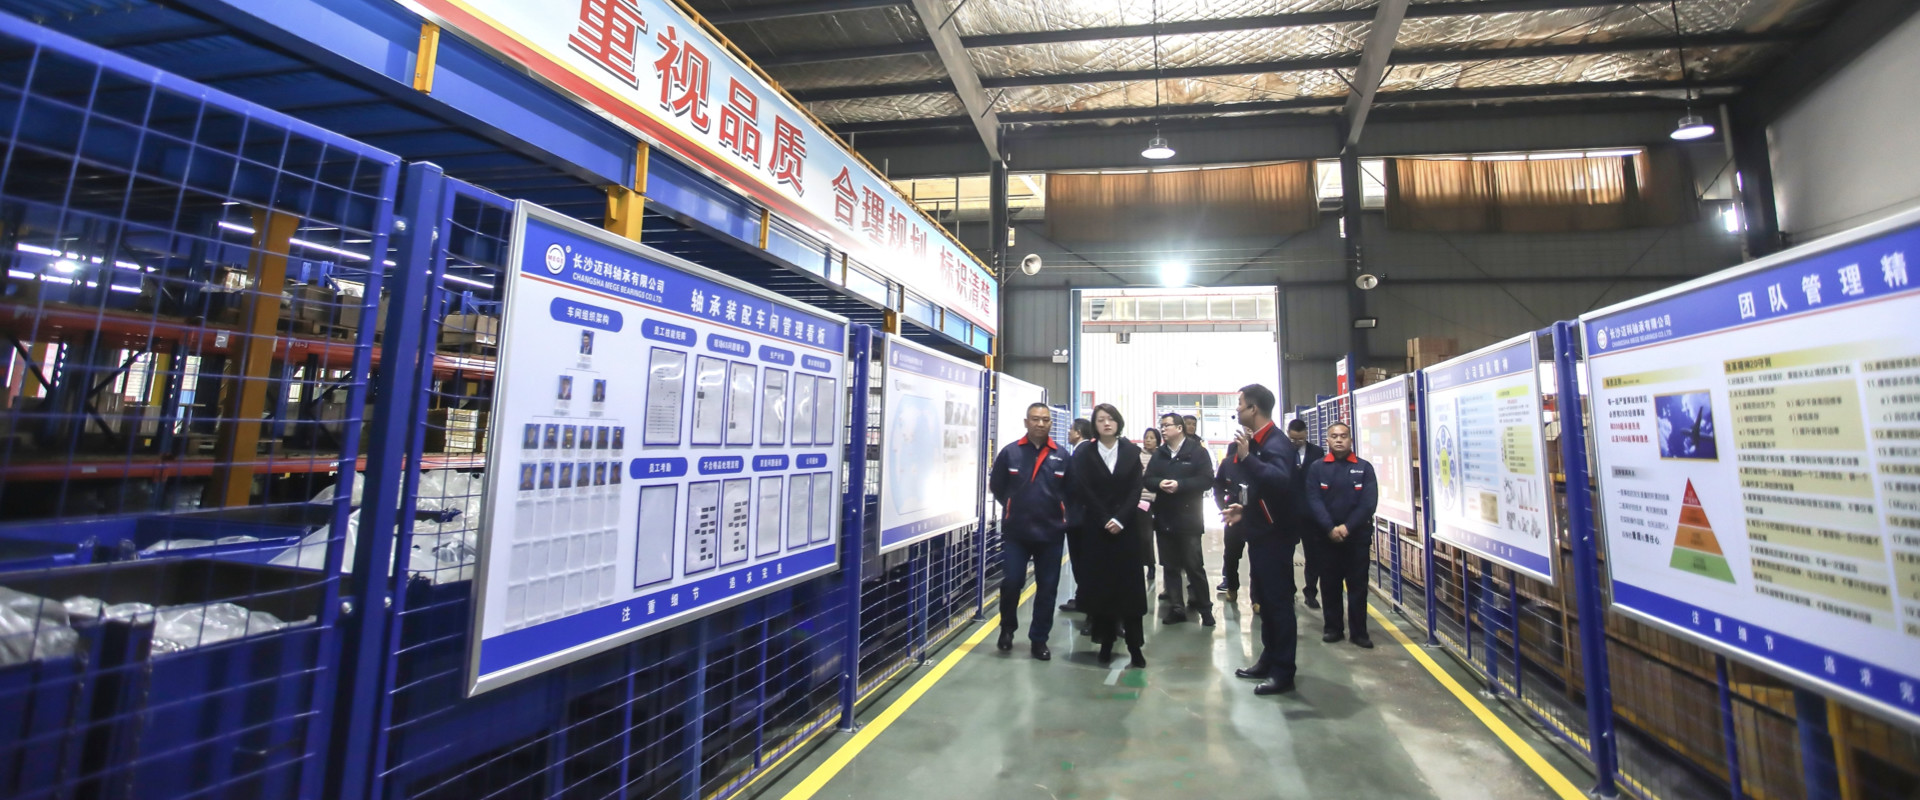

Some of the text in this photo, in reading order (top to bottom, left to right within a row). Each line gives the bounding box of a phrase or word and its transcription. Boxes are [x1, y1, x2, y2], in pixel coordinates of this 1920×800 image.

[568, 0, 990, 315] 重视品质 合理规划 标识清楚
[572, 272, 604, 287] CHANGSHA
[605, 281, 620, 292] MEGE
[620, 284, 645, 299] BEARINGS
[573, 253, 665, 294] 长沙迈科轴承有限公司
[1738, 252, 1908, 320] 团队管理精
[566, 306, 610, 325] 车间组织架构
[691, 288, 826, 345] 轴承装配车间管理看板
[1609, 314, 1671, 340] 长沙迈科轴承有限公司
[649, 462, 671, 473] 员工考勤
[622, 563, 783, 622] 注重细节 追求完美
[1692, 610, 1773, 651] 注重细节
